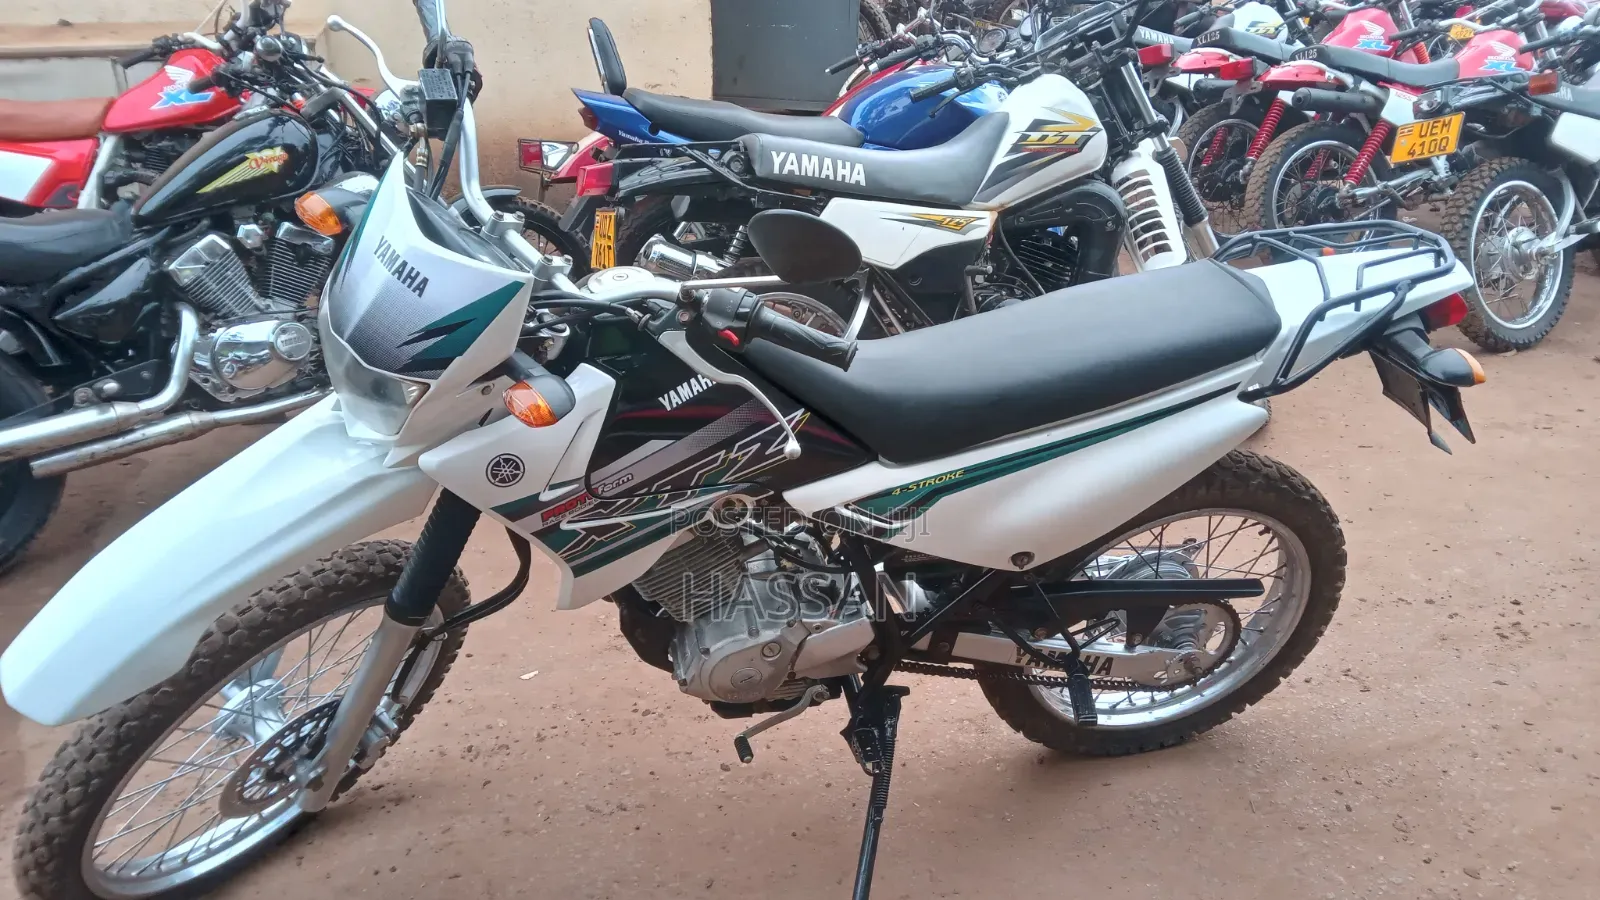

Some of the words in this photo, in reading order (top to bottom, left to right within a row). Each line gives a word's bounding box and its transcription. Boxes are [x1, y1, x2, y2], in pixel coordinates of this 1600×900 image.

[1139, 29, 1174, 45] YAMAHA
[1197, 31, 1220, 46] XL125
[1418, 117, 1453, 139] UEM
[770, 150, 866, 187] YAMAHA
[373, 234, 429, 298] YAMAHA
[657, 373, 717, 412] YAMAH
[891, 469, 965, 496] 4-STROKE
